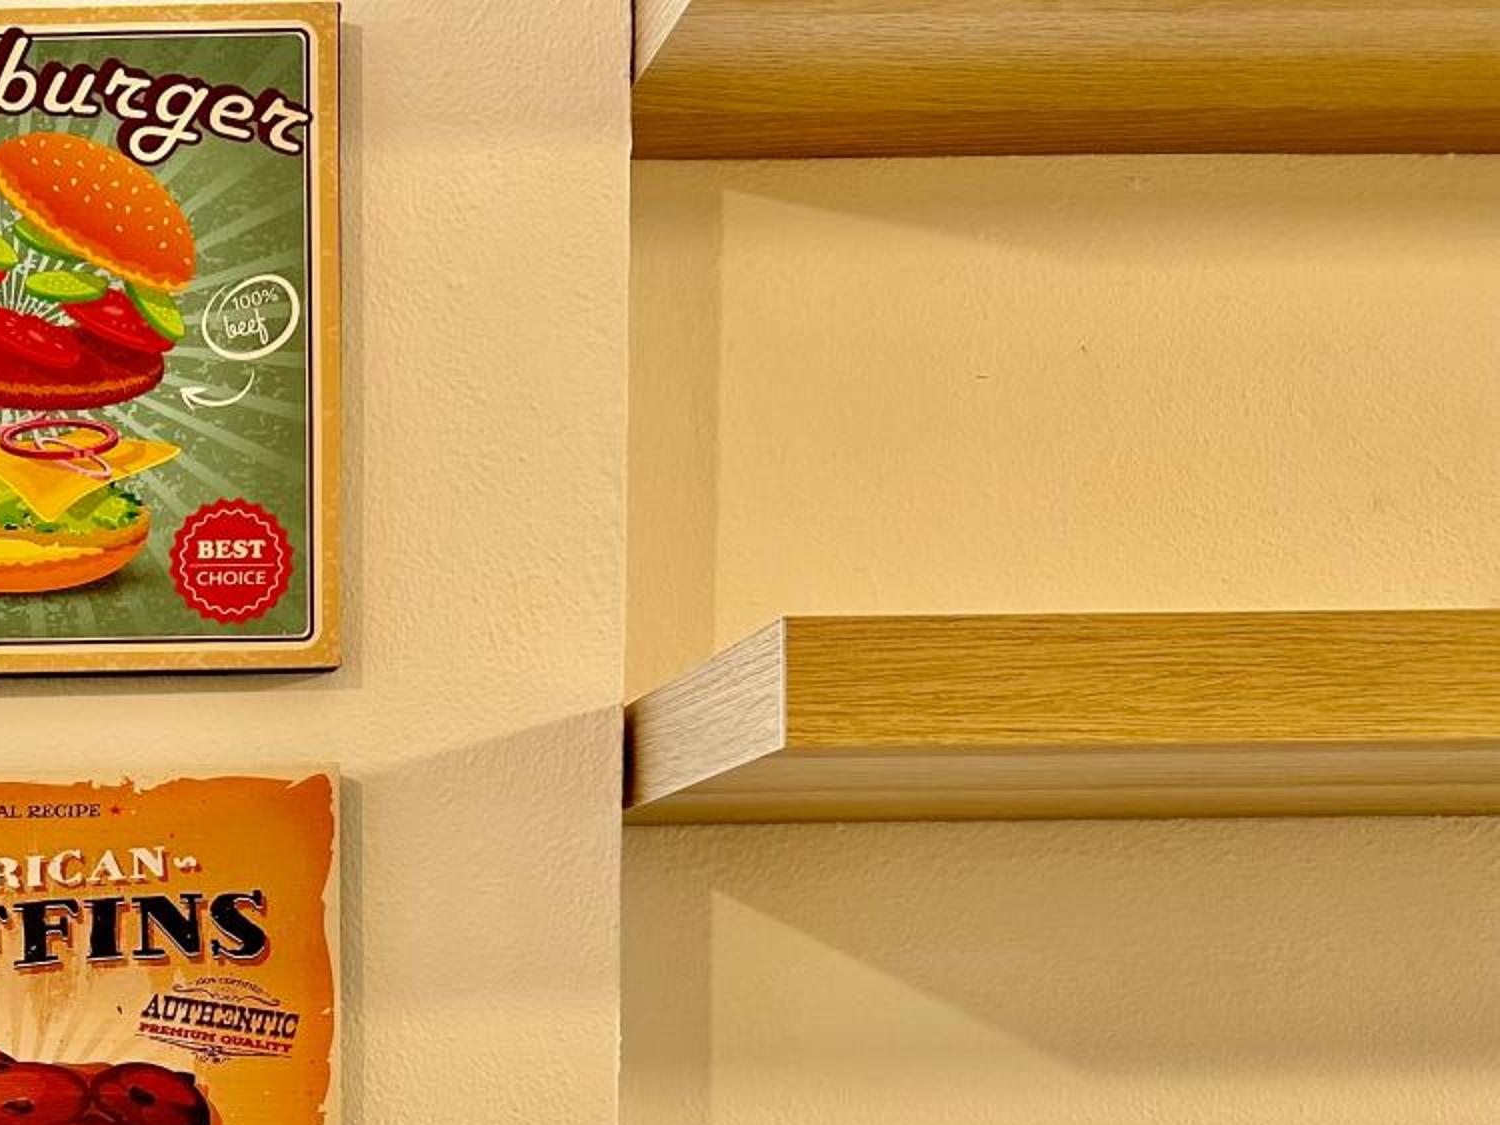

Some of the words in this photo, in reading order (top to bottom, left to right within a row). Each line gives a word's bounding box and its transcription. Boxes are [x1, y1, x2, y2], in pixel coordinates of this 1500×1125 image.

[231, 288, 278, 310] 100%
[223, 308, 268, 345] beef
[197, 539, 266, 559] BEST
[196, 571, 267, 586] CHOICE
[27, 803, 101, 819] RECIPE
[141, 993, 299, 1039] AUTHENTIC
[139, 1021, 216, 1043] PREMIUM
[221, 1034, 293, 1053] QUALITY
